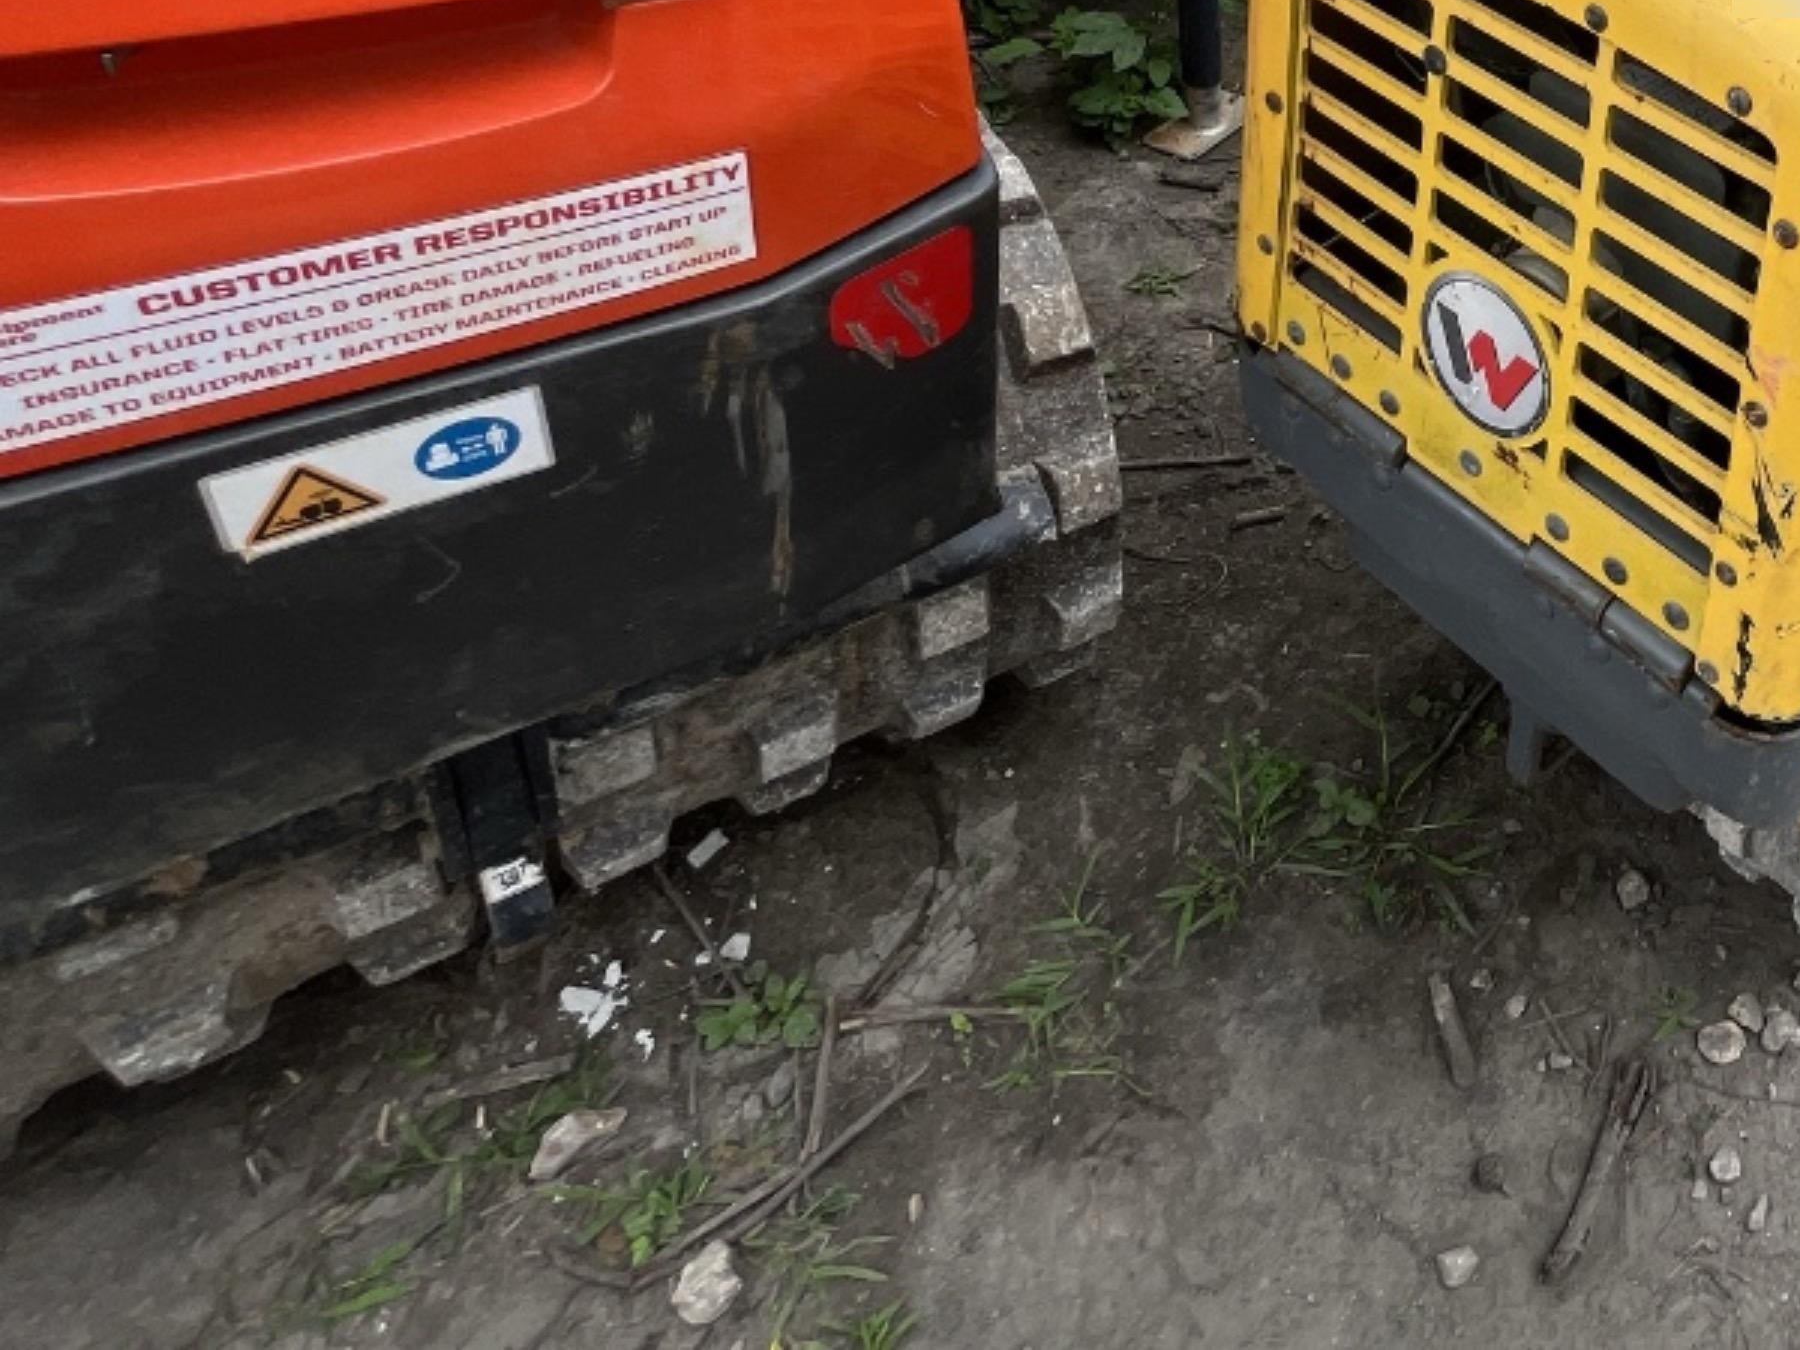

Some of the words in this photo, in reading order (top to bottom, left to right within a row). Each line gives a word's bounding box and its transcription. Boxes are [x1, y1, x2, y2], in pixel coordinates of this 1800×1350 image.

[23, 359, 200, 409] INSURANCE
[223, 339, 287, 363] FLAT
[393, 299, 453, 321] TIRE
[460, 272, 560, 307] DAMAGE
[577, 236, 696, 278] REFUELING
[71, 351, 122, 373] ALL
[130, 328, 218, 358] FLUID
[226, 305, 324, 337] LEVELS
[462, 254, 531, 283] DAILY
[538, 230, 624, 265] BEFORE
[627, 213, 693, 242] START
[698, 206, 728, 224] UP
[137, 241, 403, 317] CUSTOMER
[414, 161, 742, 256] RESPONSIBILITY
[101, 399, 143, 416] TO
[150, 356, 317, 406] EQUIPMENT
[338, 323, 450, 361] BATTERY
[455, 276, 625, 331] MAINTENANCE
[639, 245, 742, 282] CLEANING
